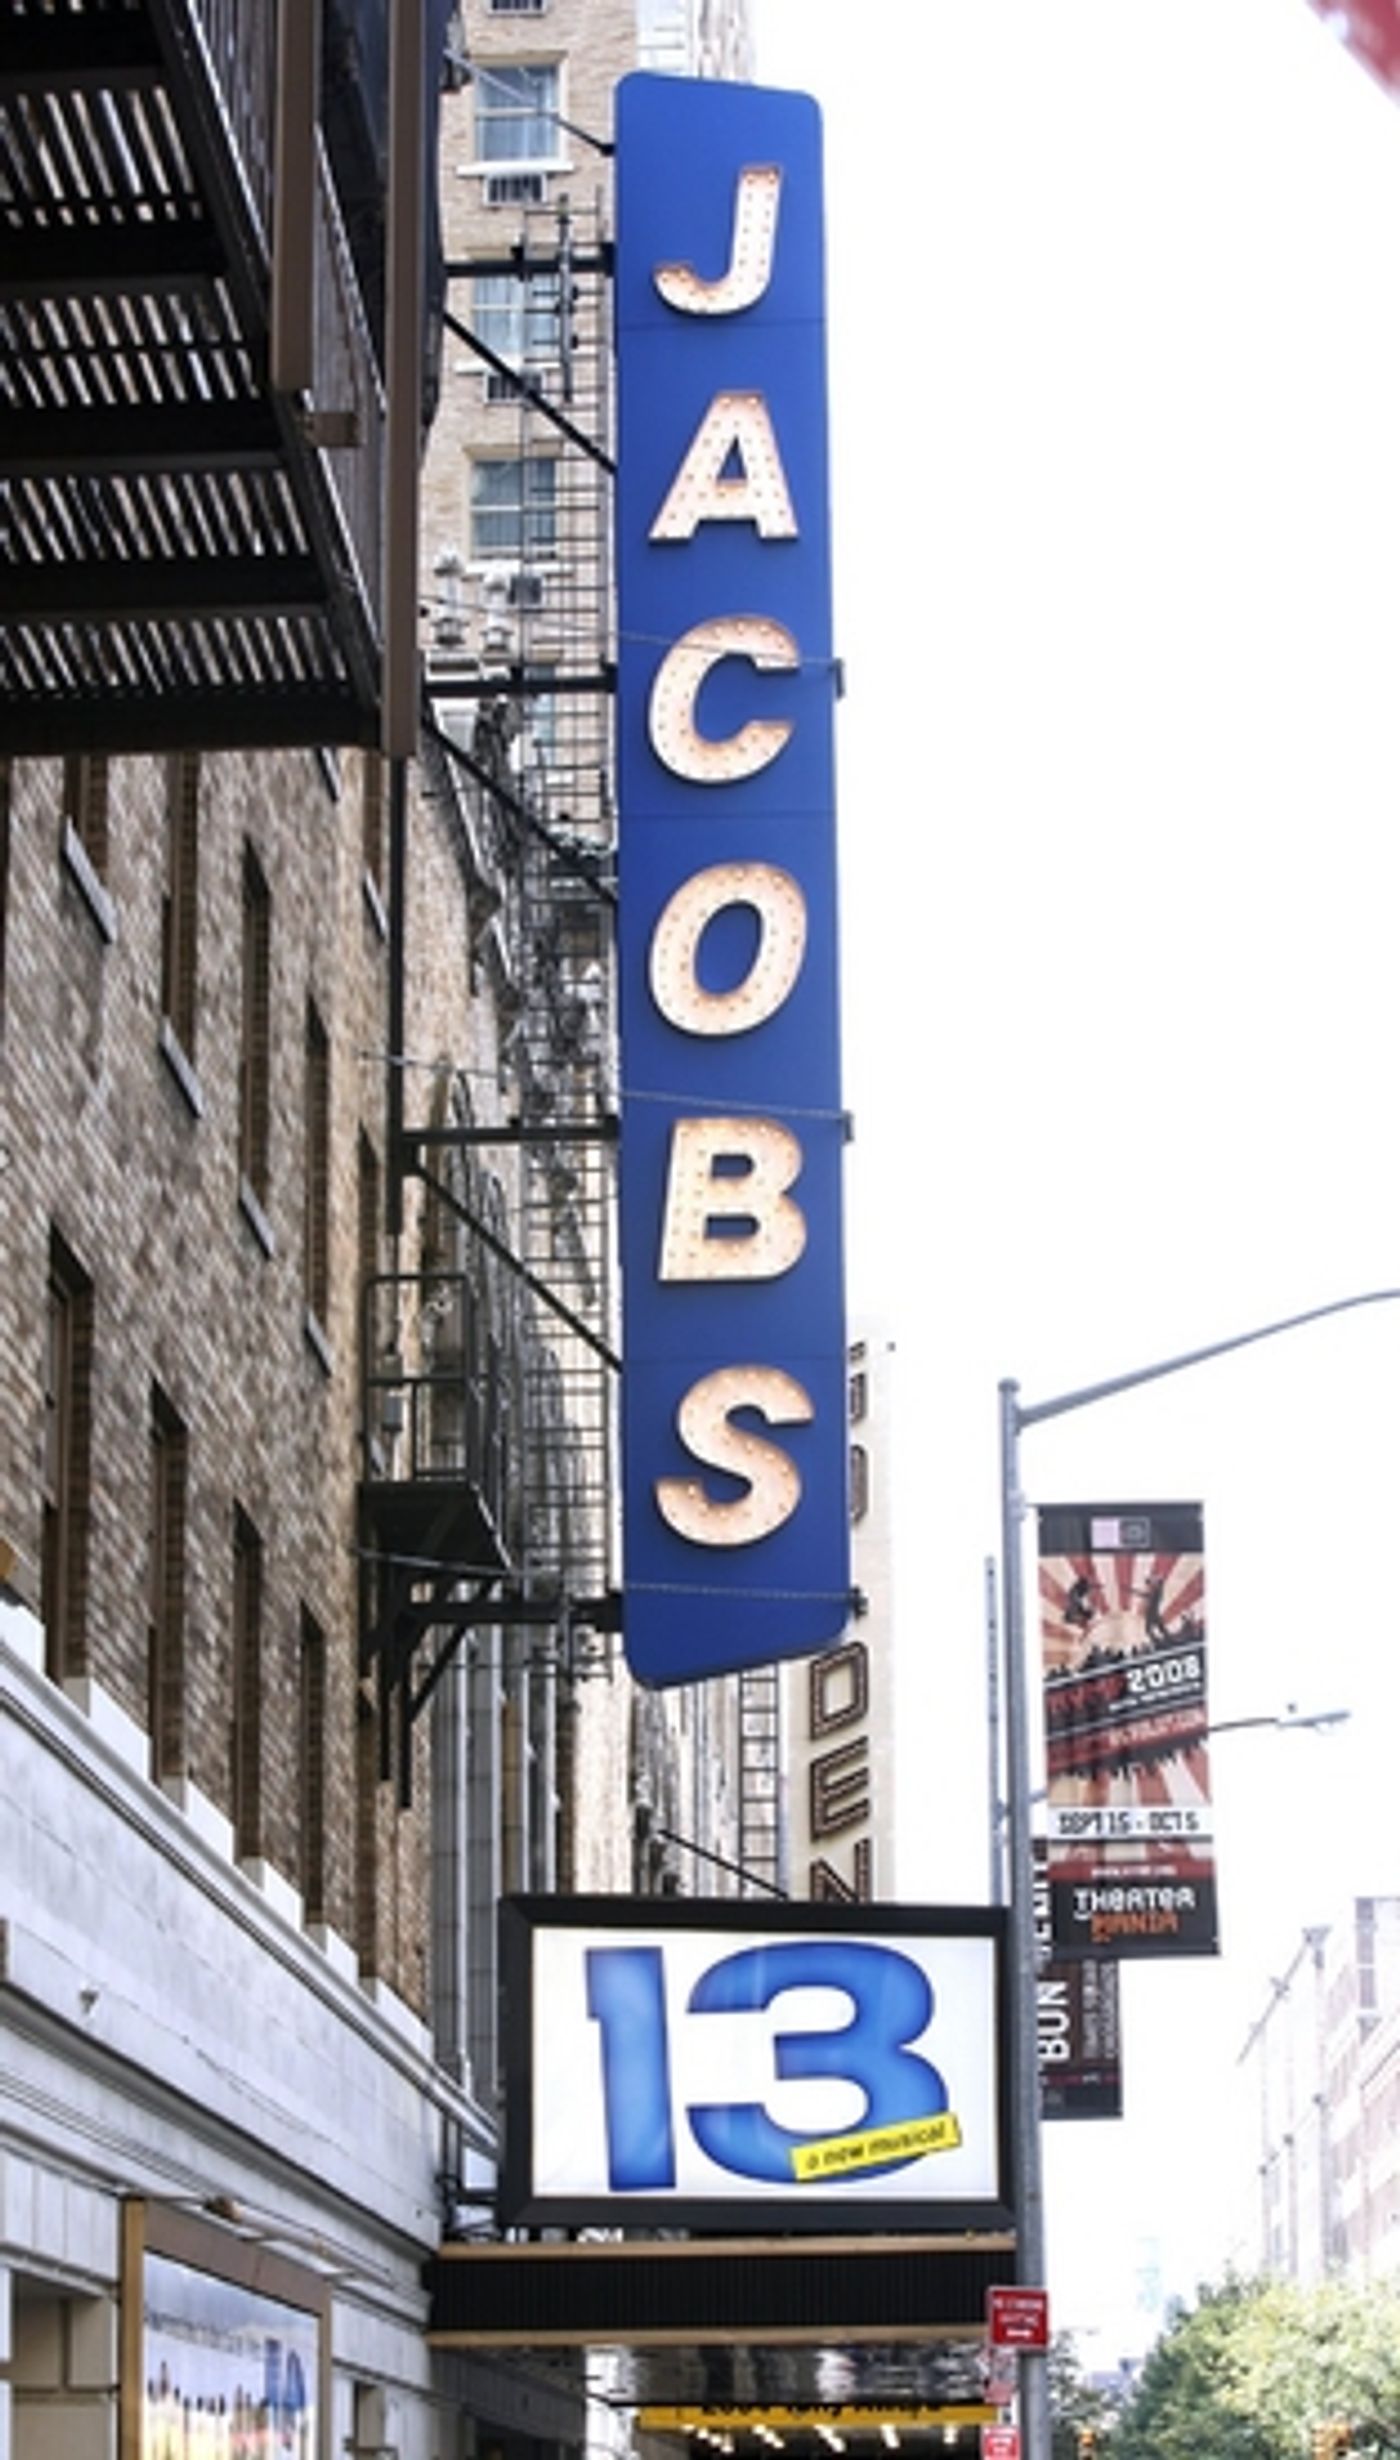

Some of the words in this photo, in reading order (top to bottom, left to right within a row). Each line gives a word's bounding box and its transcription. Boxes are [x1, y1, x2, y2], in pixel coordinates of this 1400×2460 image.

[649, 164, 814, 1547] JACOBS
[1126, 1655, 1200, 1692] 2008
[1106, 1811, 1130, 1832] 15
[1150, 1811, 1182, 1830] OCT
[1074, 1886, 1195, 1920] THEATER
[583, 1940, 951, 2192] 13
[806, 2154, 818, 2169] a
[823, 2143, 864, 2164] new
[869, 2122, 946, 2155] musical
